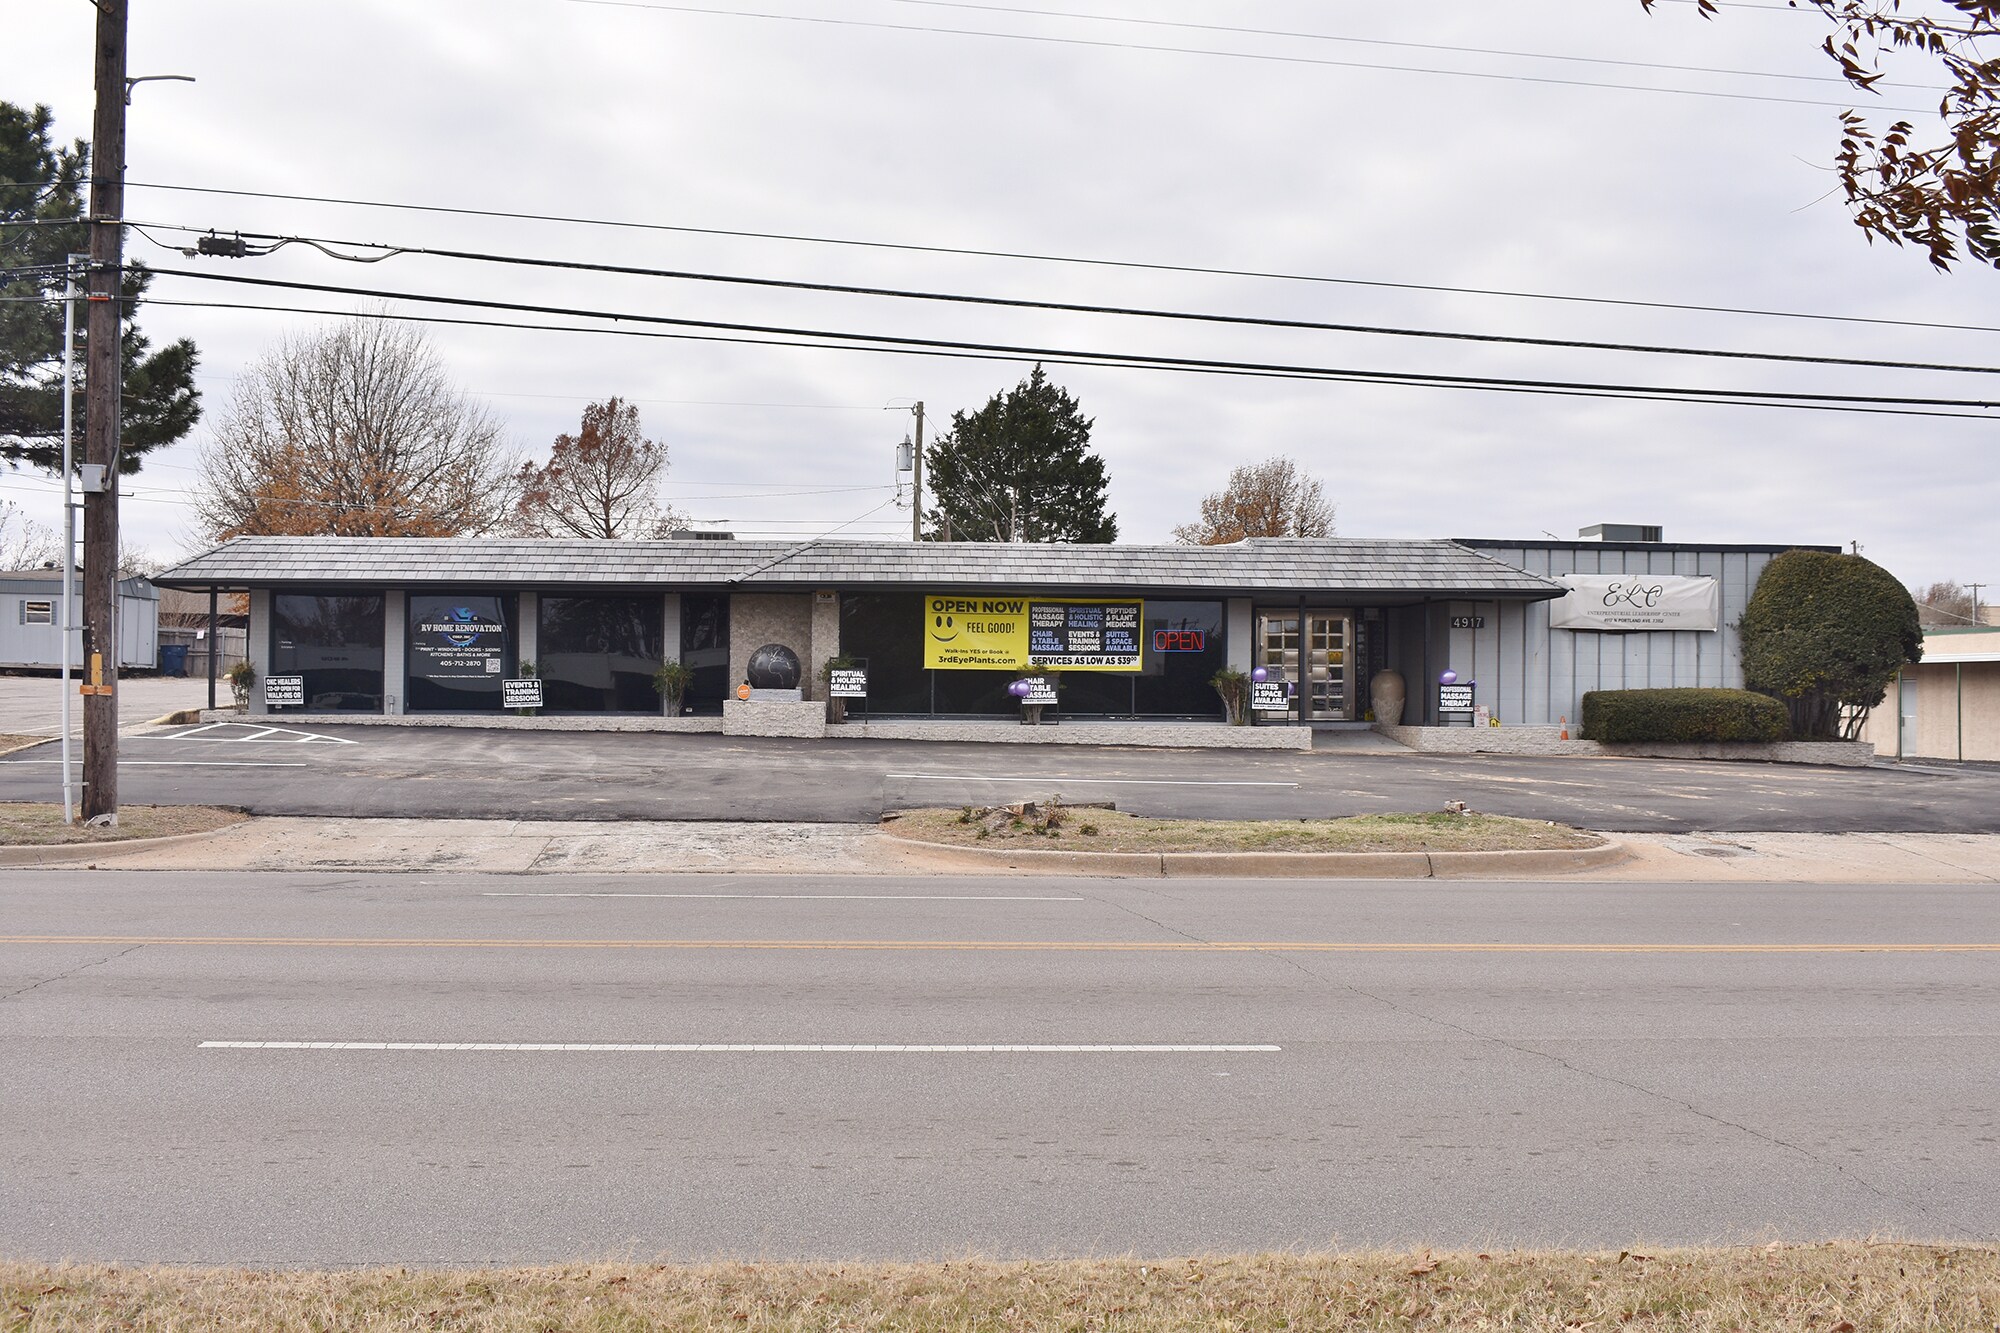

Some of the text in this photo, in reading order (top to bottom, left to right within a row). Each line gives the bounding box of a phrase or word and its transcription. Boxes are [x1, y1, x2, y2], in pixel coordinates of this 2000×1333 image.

[932, 600, 1024, 613] OPEN NOW
[967, 622, 1015, 633] FEEL GOOD!
[1454, 617, 1482, 628] 4917
[1156, 632, 1202, 650] OPEN
[938, 656, 1016, 664] 3rdEyePlants.com
